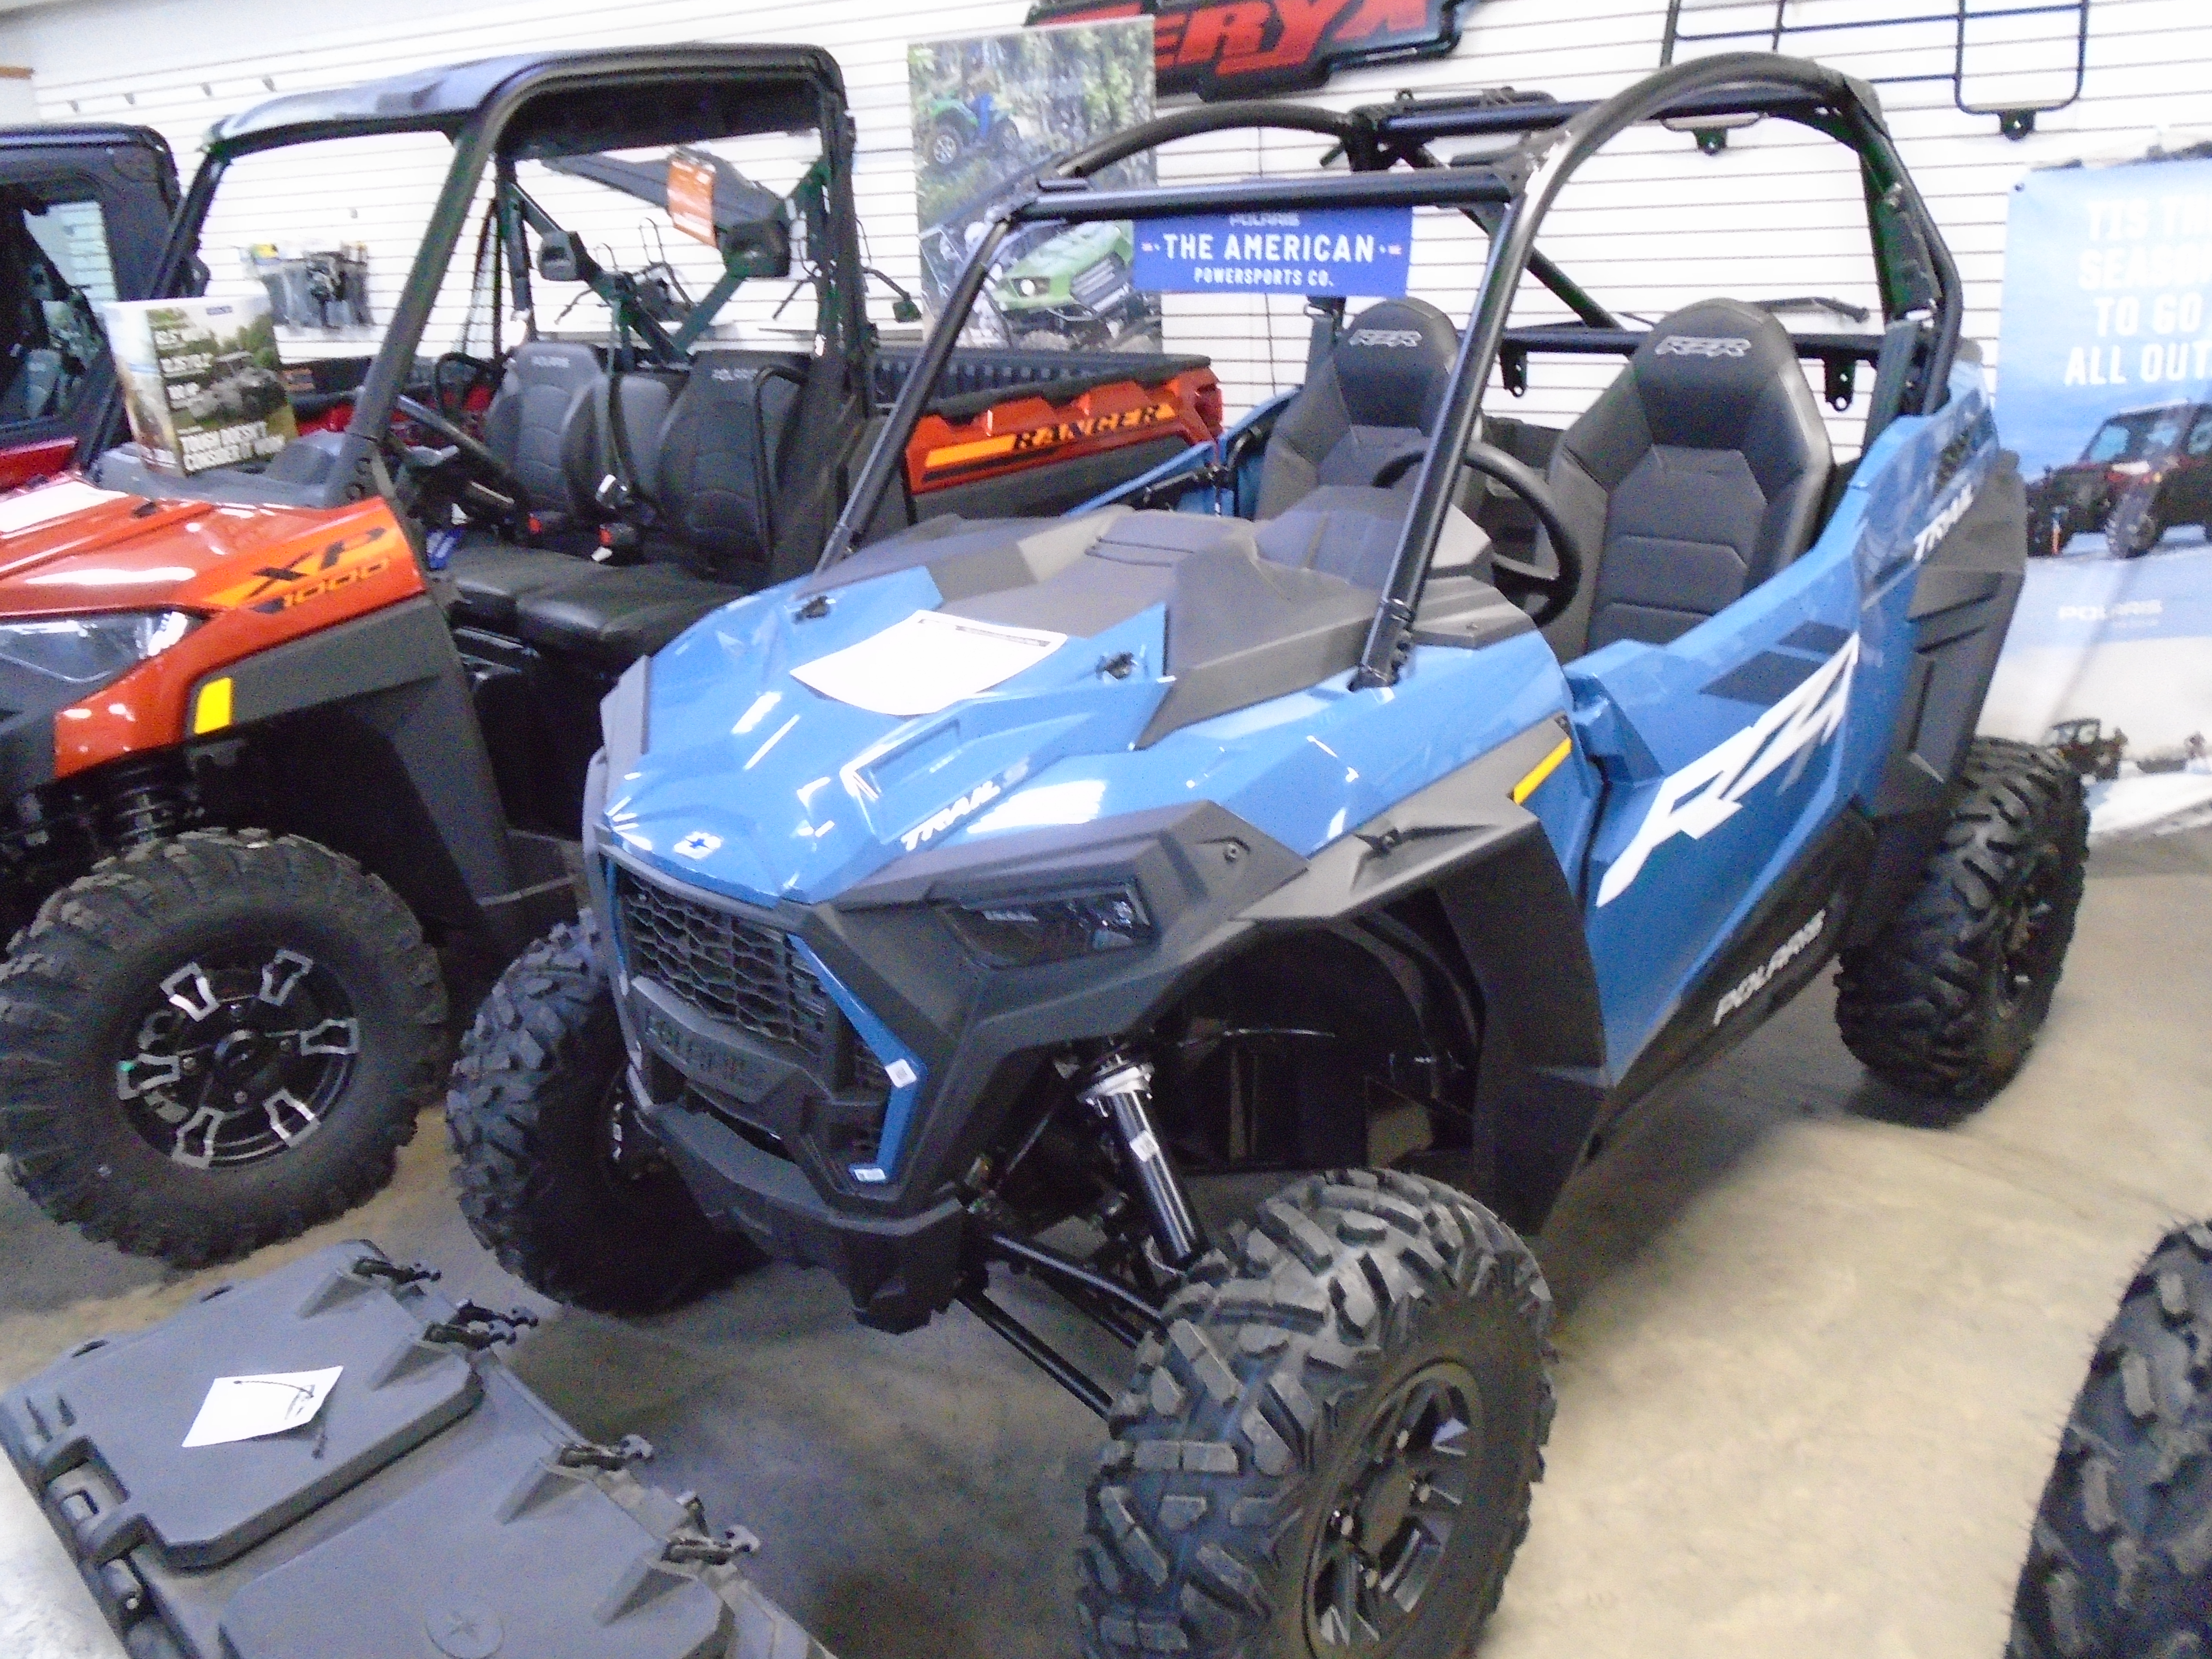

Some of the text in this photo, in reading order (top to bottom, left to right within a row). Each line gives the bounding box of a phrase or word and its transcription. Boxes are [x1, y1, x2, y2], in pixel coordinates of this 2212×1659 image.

[2159, 194, 2212, 236] TH
[1163, 234, 1374, 262] THE AMERICAN
[1194, 267, 1334, 287] POWERSPORTS CO.
[2094, 292, 2203, 337] TO GO
[2064, 344, 2127, 386] ALL
[1014, 404, 1170, 451] RANGER
[245, 526, 386, 600] XP
[281, 557, 391, 608] 1000
[901, 780, 1001, 851] TRAIL
